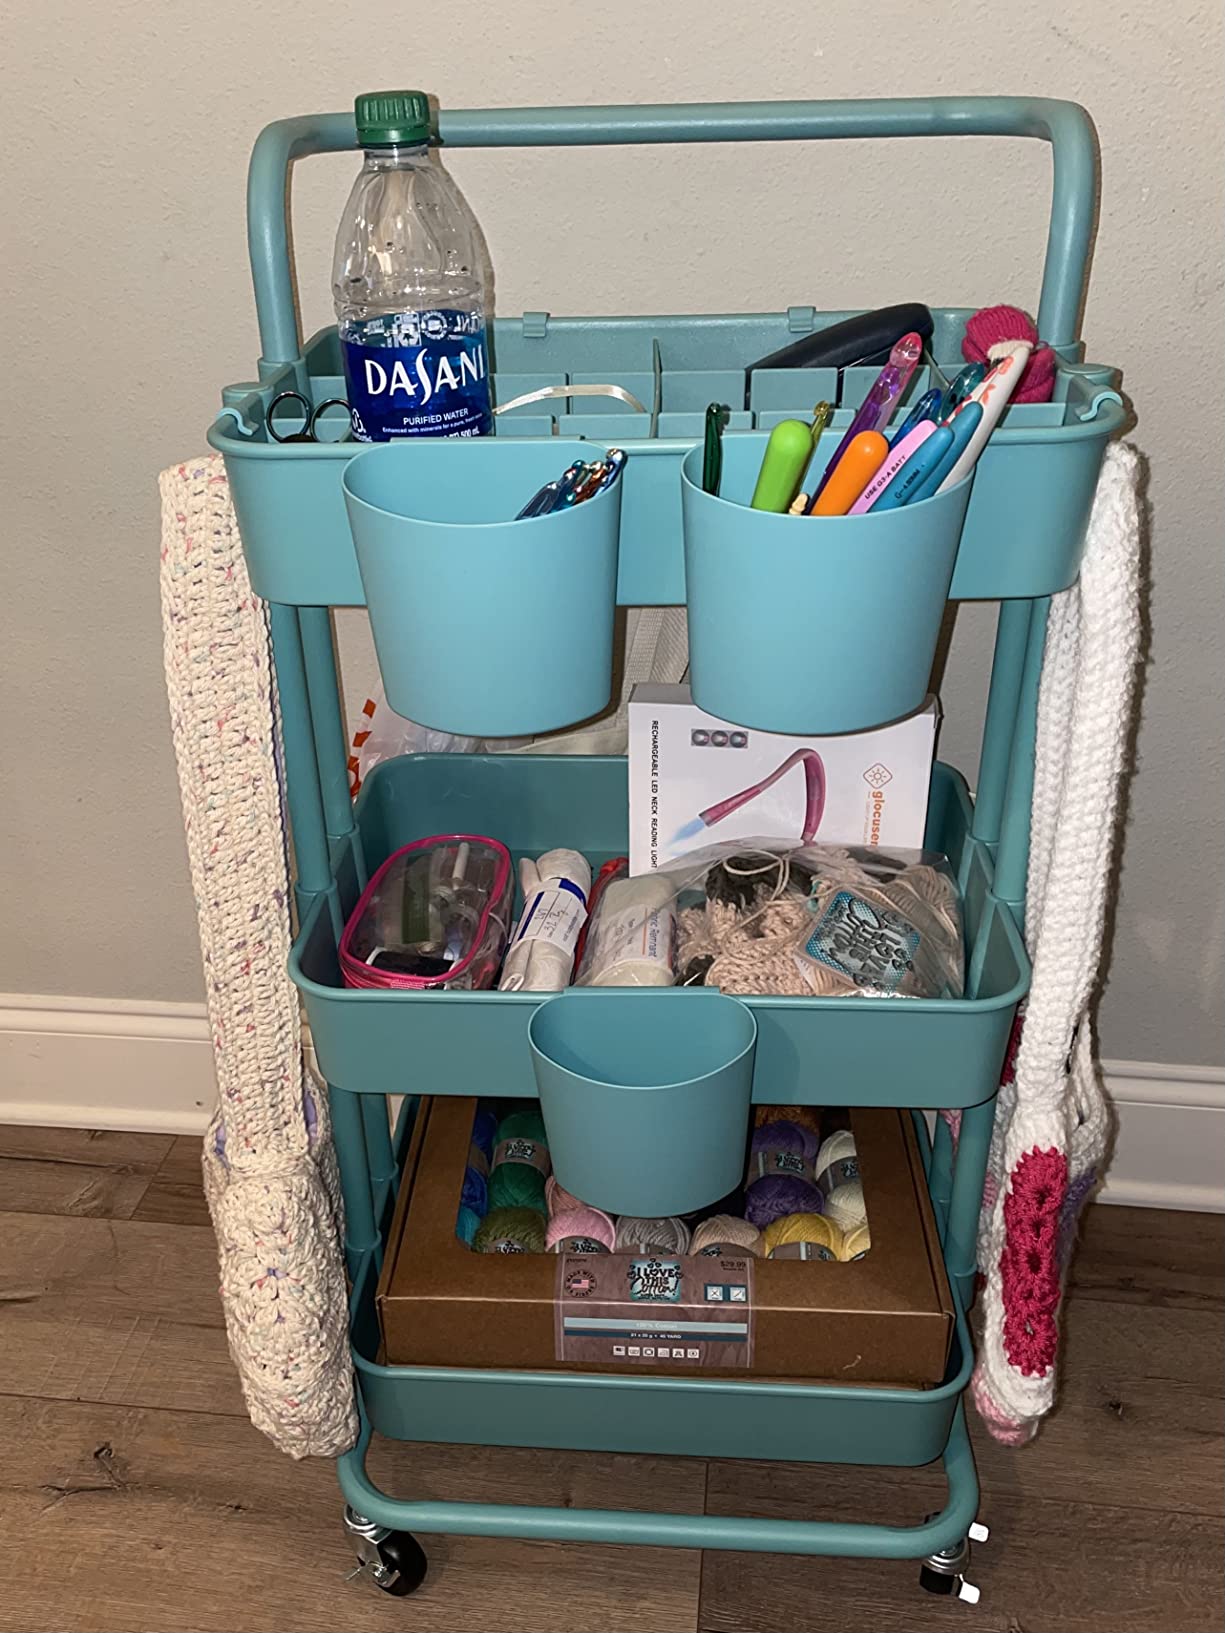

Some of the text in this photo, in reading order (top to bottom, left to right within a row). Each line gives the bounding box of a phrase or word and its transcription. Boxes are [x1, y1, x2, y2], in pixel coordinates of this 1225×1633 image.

[364, 344, 486, 405] DASANI
[403, 411, 442, 426] PURIFIED
[443, 407, 469, 421] WATER
[864, 486, 878, 500] USE
[891, 455, 906, 474] BATT
[651, 720, 659, 777] RECHARGEABLE
[651, 780, 659, 793] LED
[651, 796, 659, 815] NECK
[870, 791, 885, 848] glocuser
[650, 850, 658, 869] LIGHT
[644, 1268, 675, 1278] LOVE
[645, 1276, 669, 1285] THIS
